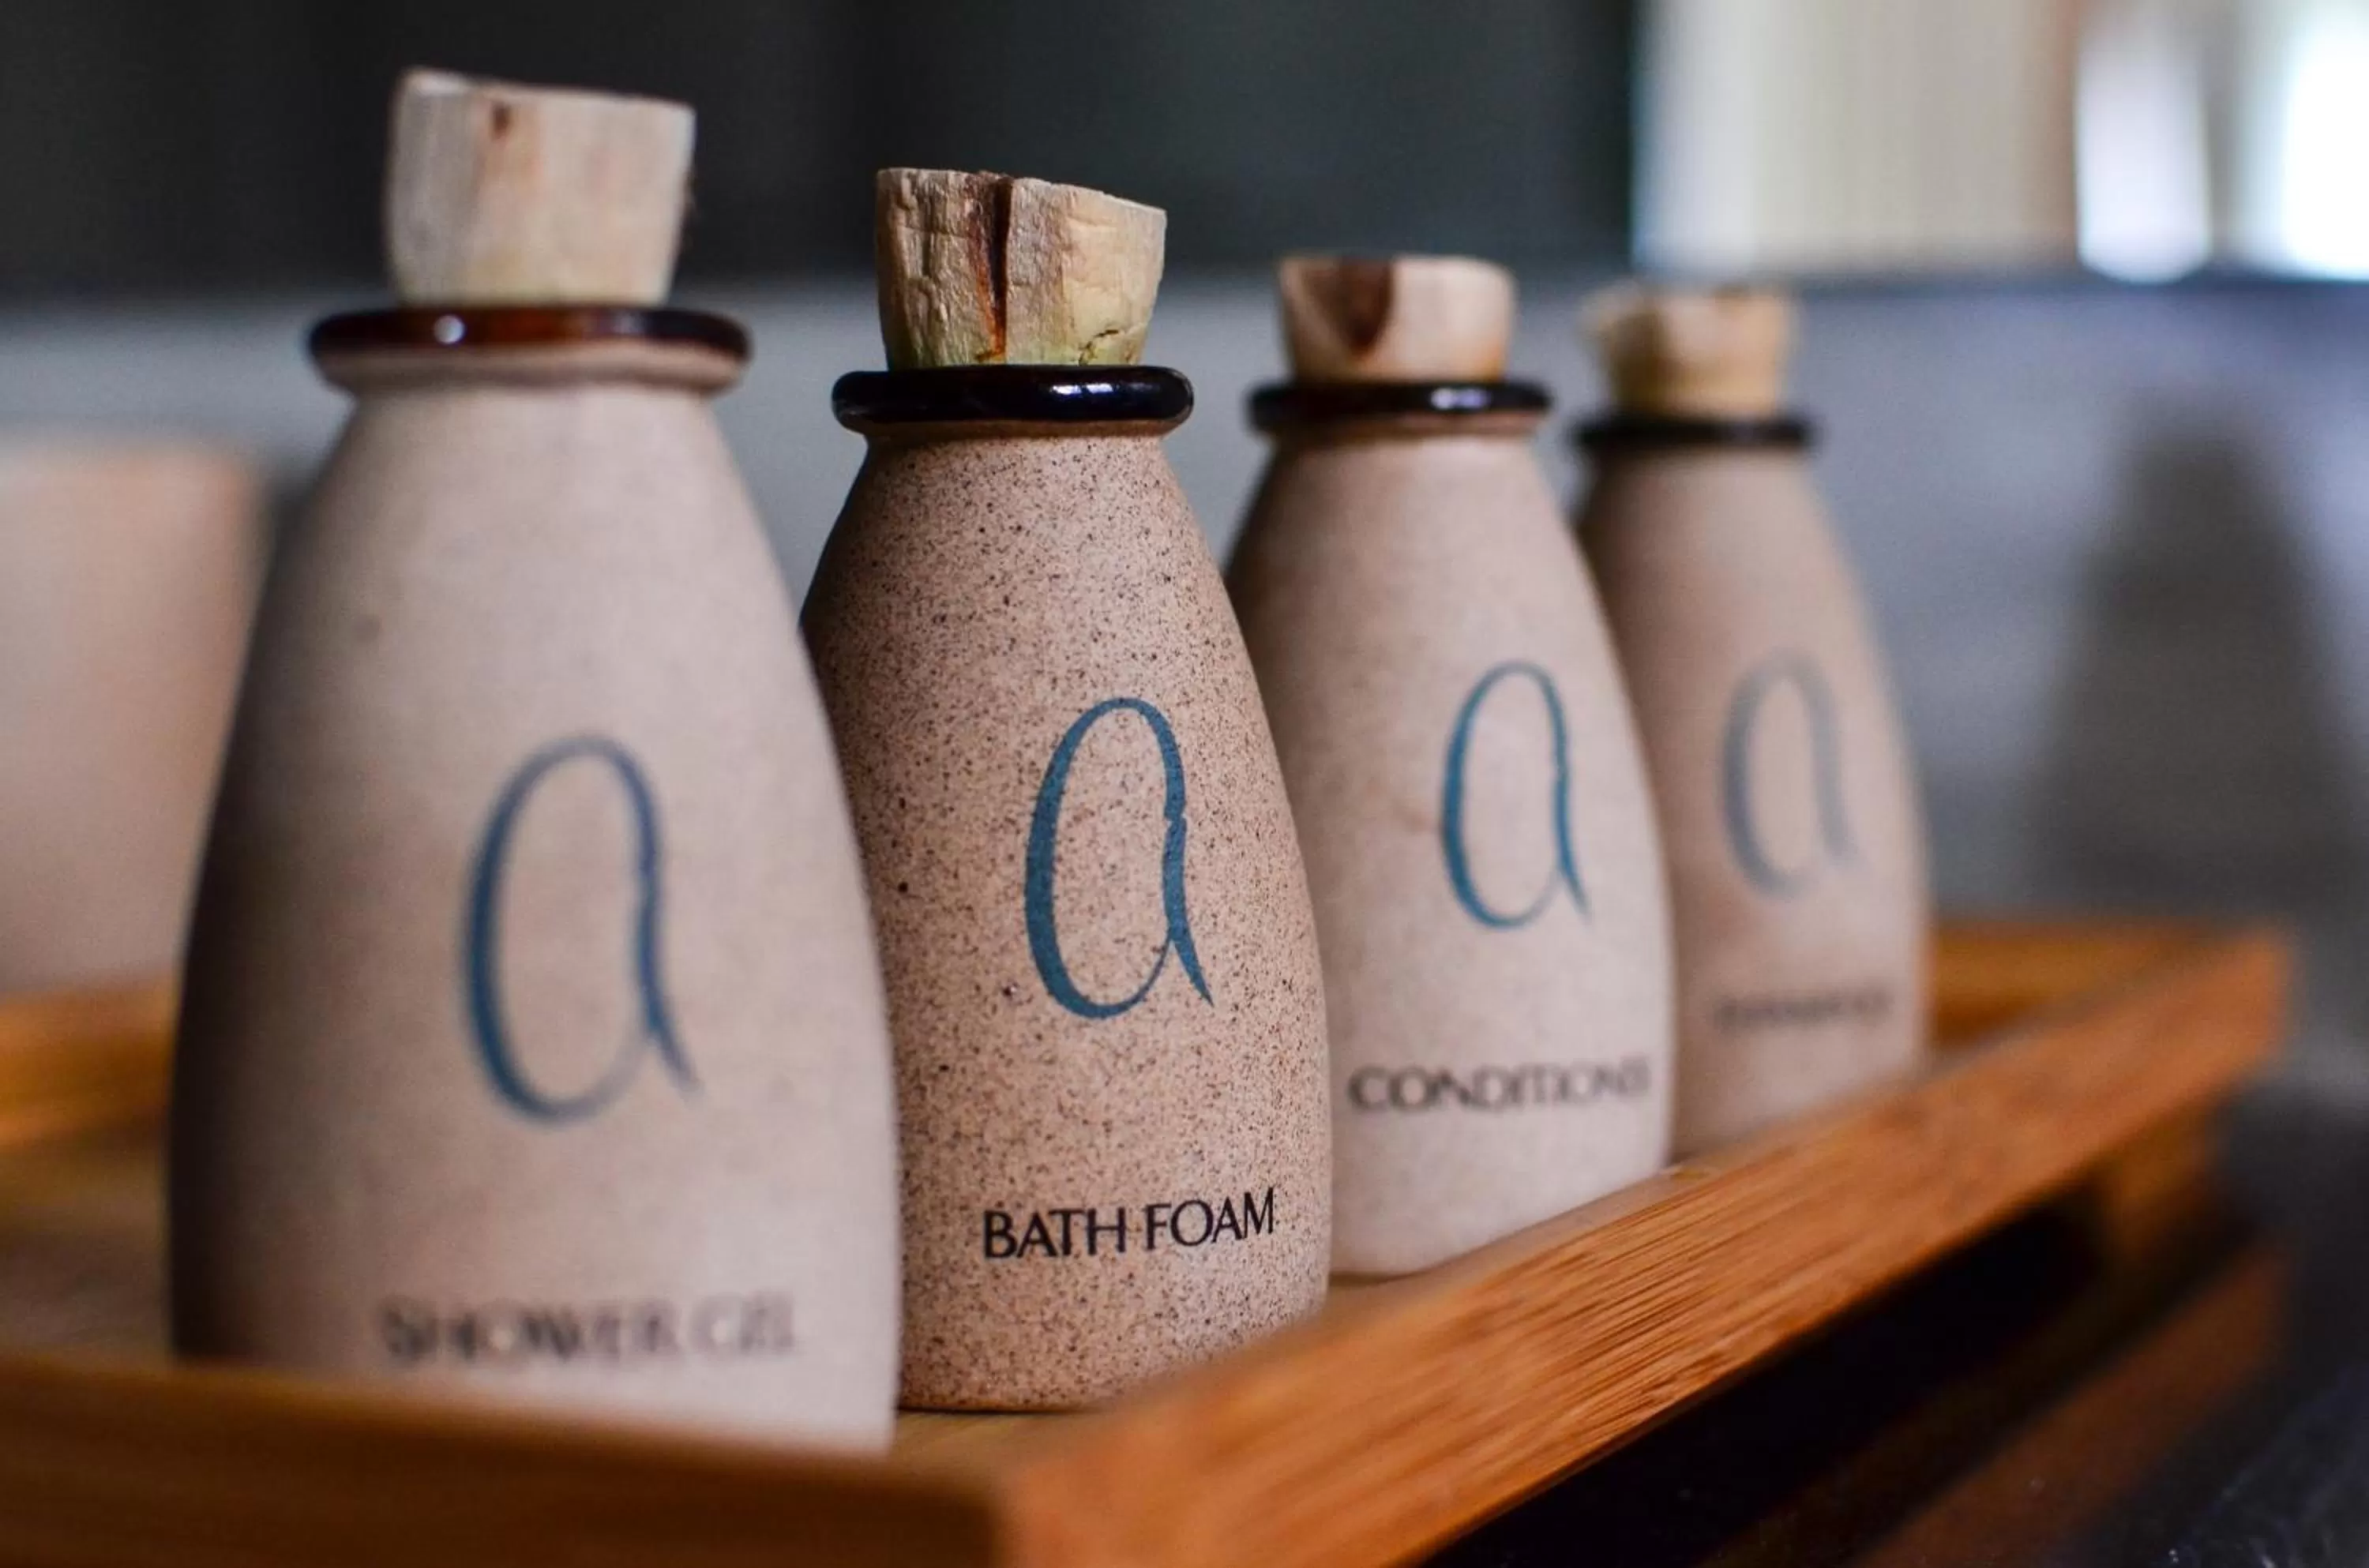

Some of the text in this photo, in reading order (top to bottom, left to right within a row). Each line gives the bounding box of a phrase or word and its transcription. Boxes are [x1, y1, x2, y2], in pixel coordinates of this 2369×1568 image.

[983, 1187, 1275, 1259] BATH FOAM
[377, 1296, 682, 1361] SHOWER
